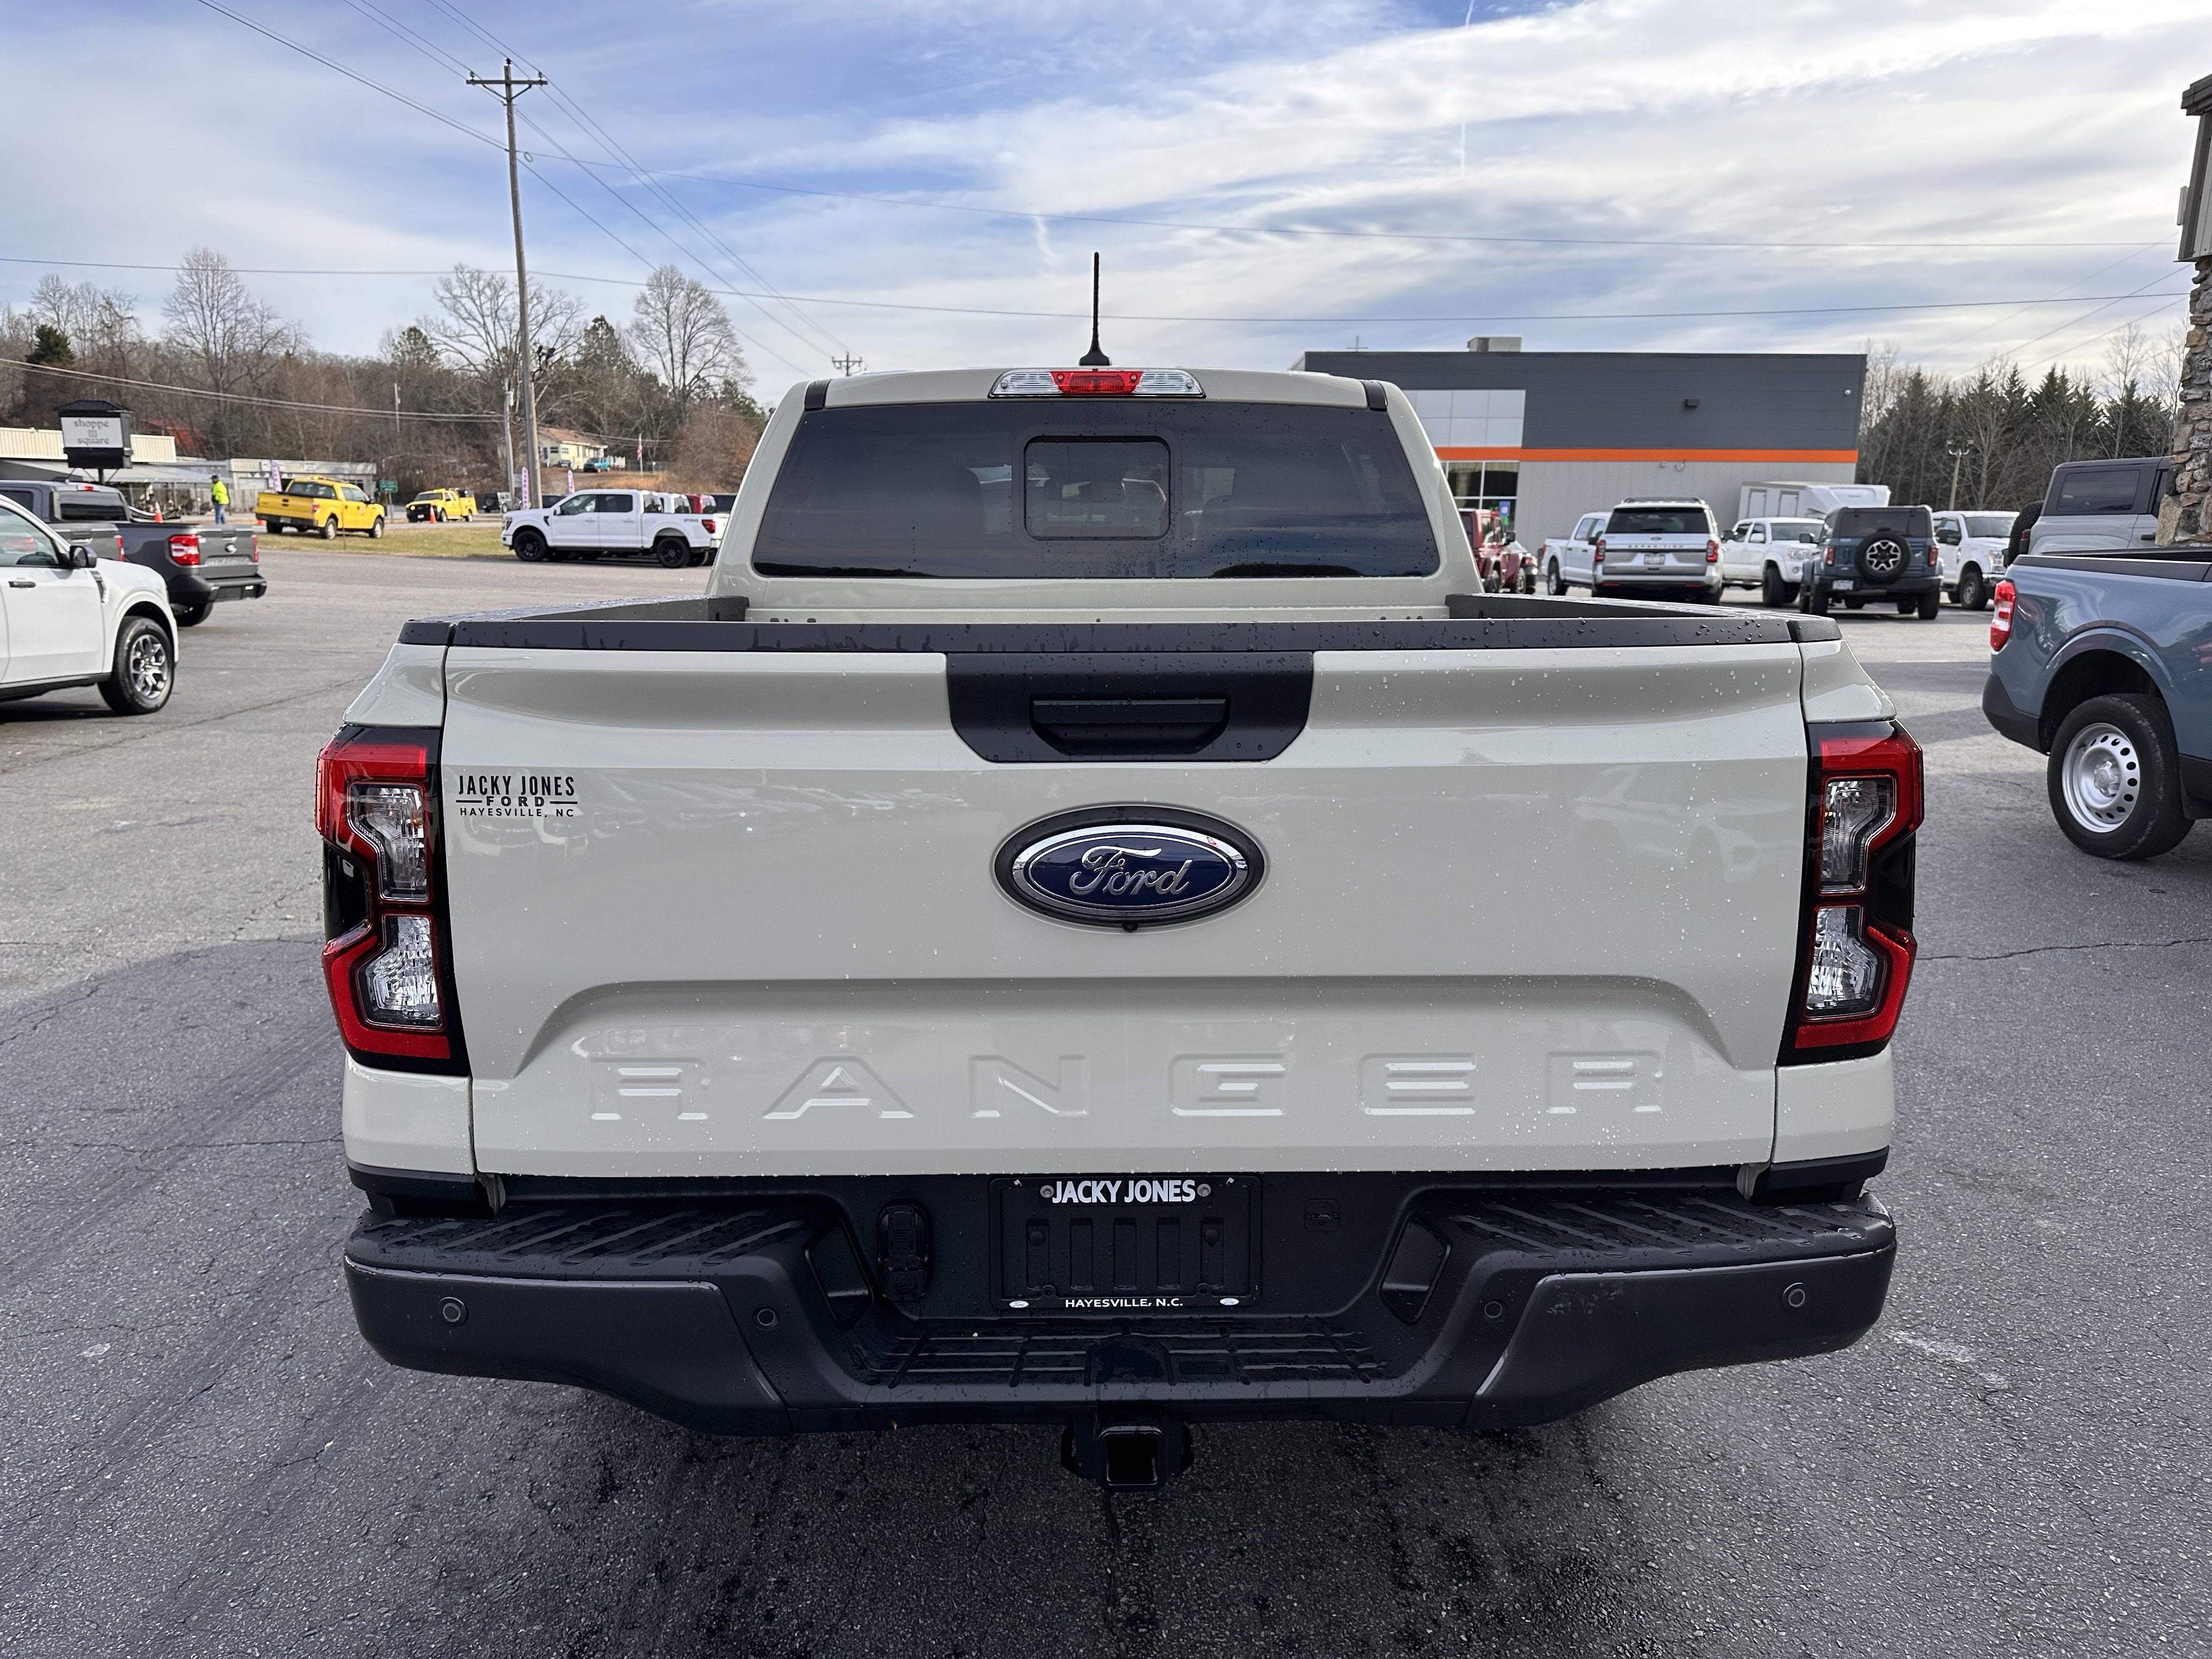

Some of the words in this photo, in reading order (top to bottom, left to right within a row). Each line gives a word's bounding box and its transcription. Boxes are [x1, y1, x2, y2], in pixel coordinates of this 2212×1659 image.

[74, 419, 109, 430] shoppe
[77, 437, 109, 445] square
[459, 775, 511, 795] JACKY
[521, 776, 575, 796] JONES
[486, 796, 545, 807] FORD
[460, 808, 548, 817] HAYESVILLE,
[556, 809, 574, 817] NC
[1069, 845, 1193, 895] Ford
[589, 1051, 1664, 1121] RANGER
[1052, 1181, 1122, 1204] JACKY
[1124, 1180, 1196, 1203] JONES
[1065, 1298, 1152, 1308] HAYESVILLE,
[1155, 1298, 1183, 1307] N.C.
